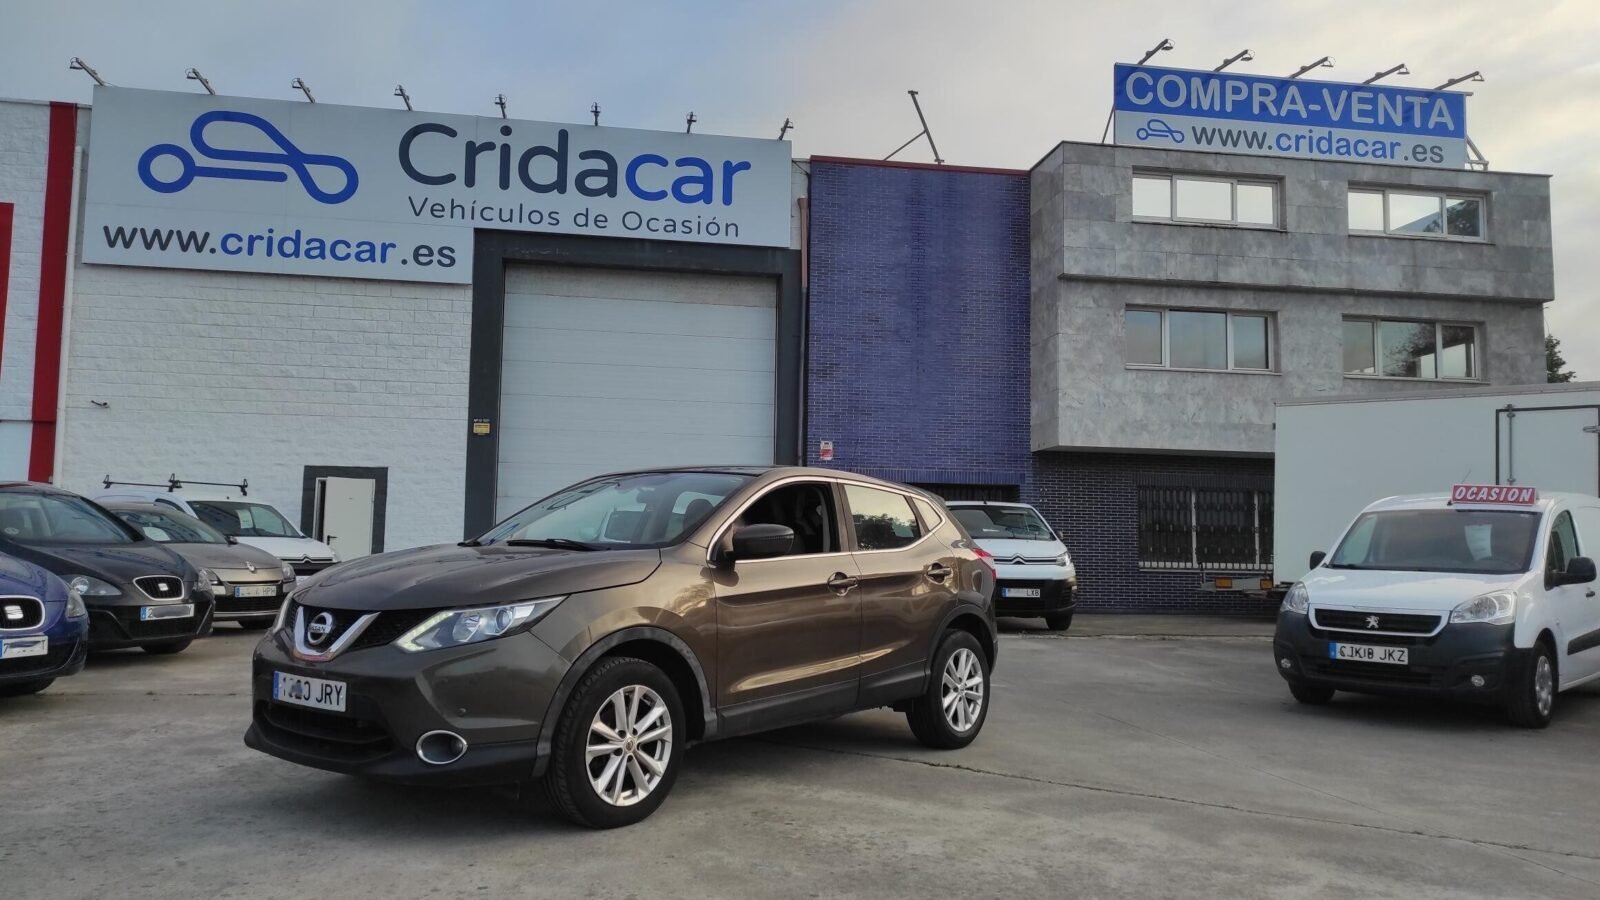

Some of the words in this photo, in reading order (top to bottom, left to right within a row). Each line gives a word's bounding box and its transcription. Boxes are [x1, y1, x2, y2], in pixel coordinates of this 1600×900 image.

[1125, 71, 1455, 131] COMPRA-VENTA
[398, 122, 752, 207] Cridacar
[1191, 125, 1444, 164] www.cridacar.es
[408, 195, 561, 227] Vehículos
[573, 207, 609, 230] de
[621, 210, 740, 238] Ocasión
[103, 224, 457, 268] www.cridacar.es
[1454, 486, 1533, 502] OCASION
[1379, 648, 1406, 663] JKZ
[315, 682, 343, 706] JRY
